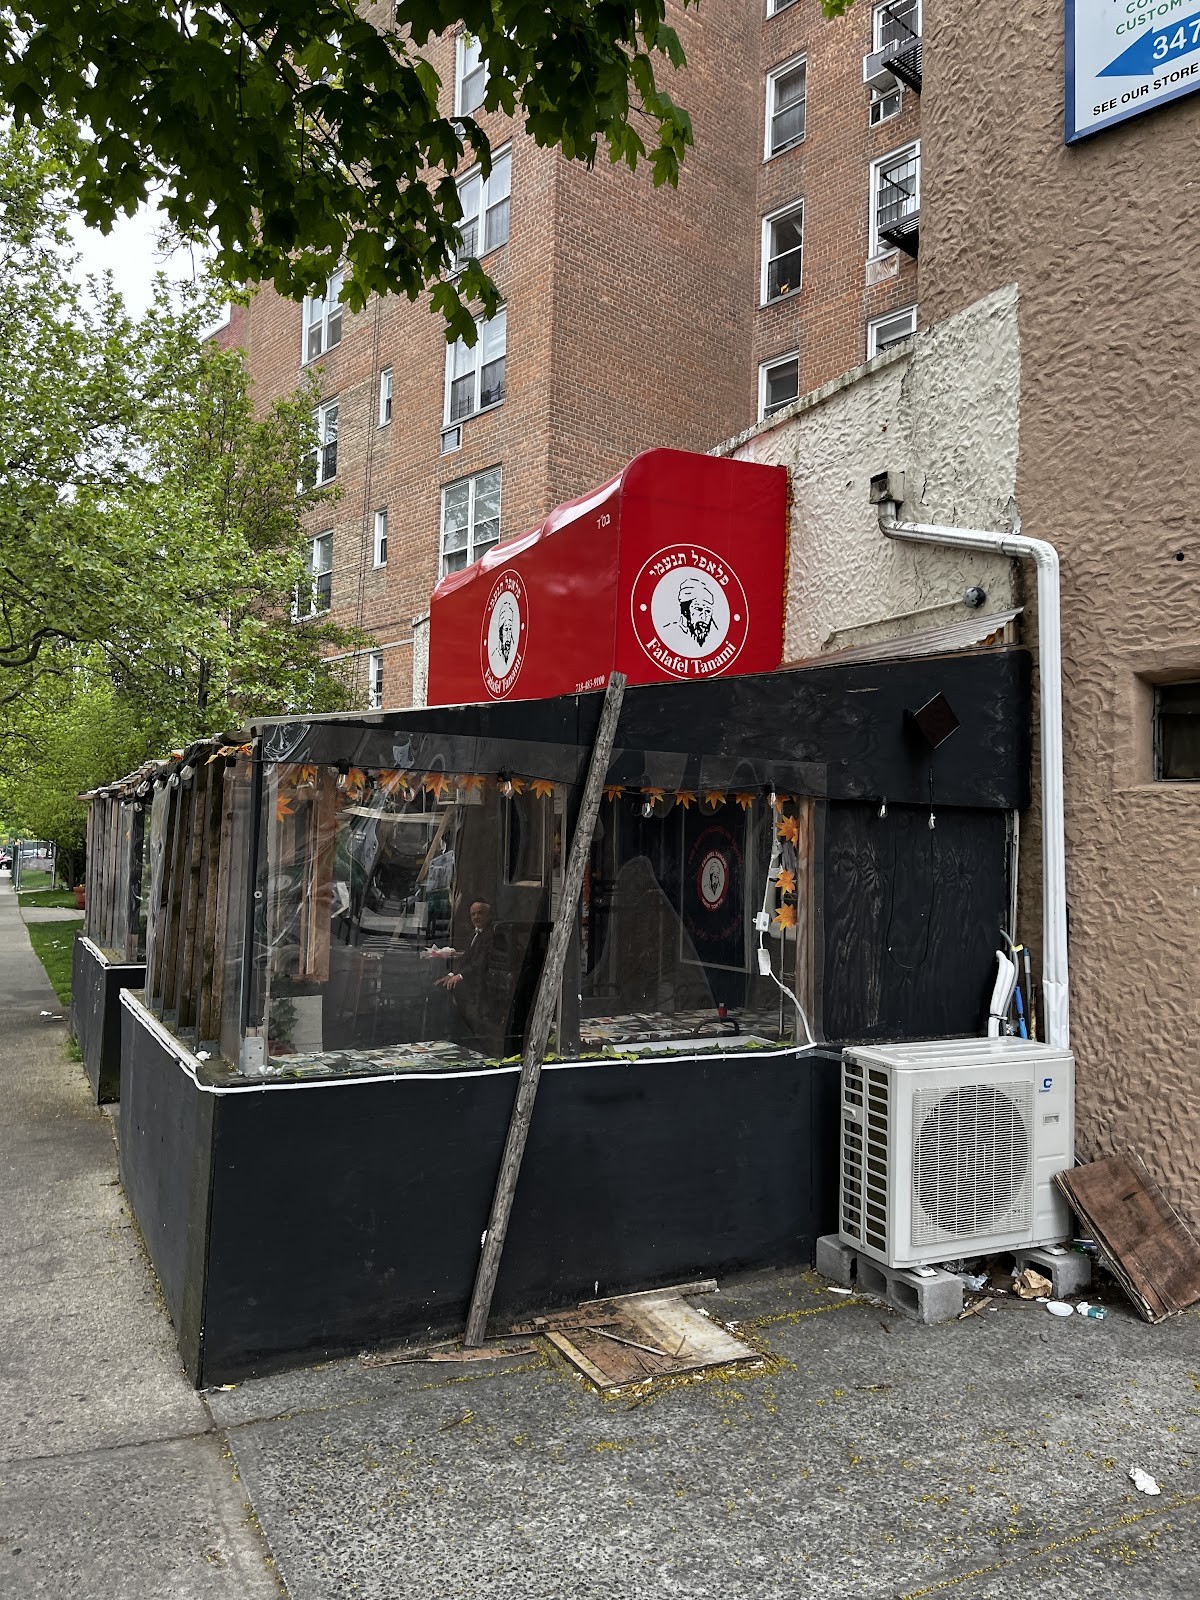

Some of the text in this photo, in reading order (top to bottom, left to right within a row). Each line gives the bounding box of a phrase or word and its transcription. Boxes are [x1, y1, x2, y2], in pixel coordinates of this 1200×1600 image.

[1115, 0, 1182, 35] CUSTOM
[1153, 18, 1200, 60] 347
[1093, 62, 1199, 116] SEE OUR STORE
[648, 549, 730, 586] פלאפל תנעמי
[645, 637, 737, 674] Falafel Tanami
[484, 667, 501, 693] Falafel
